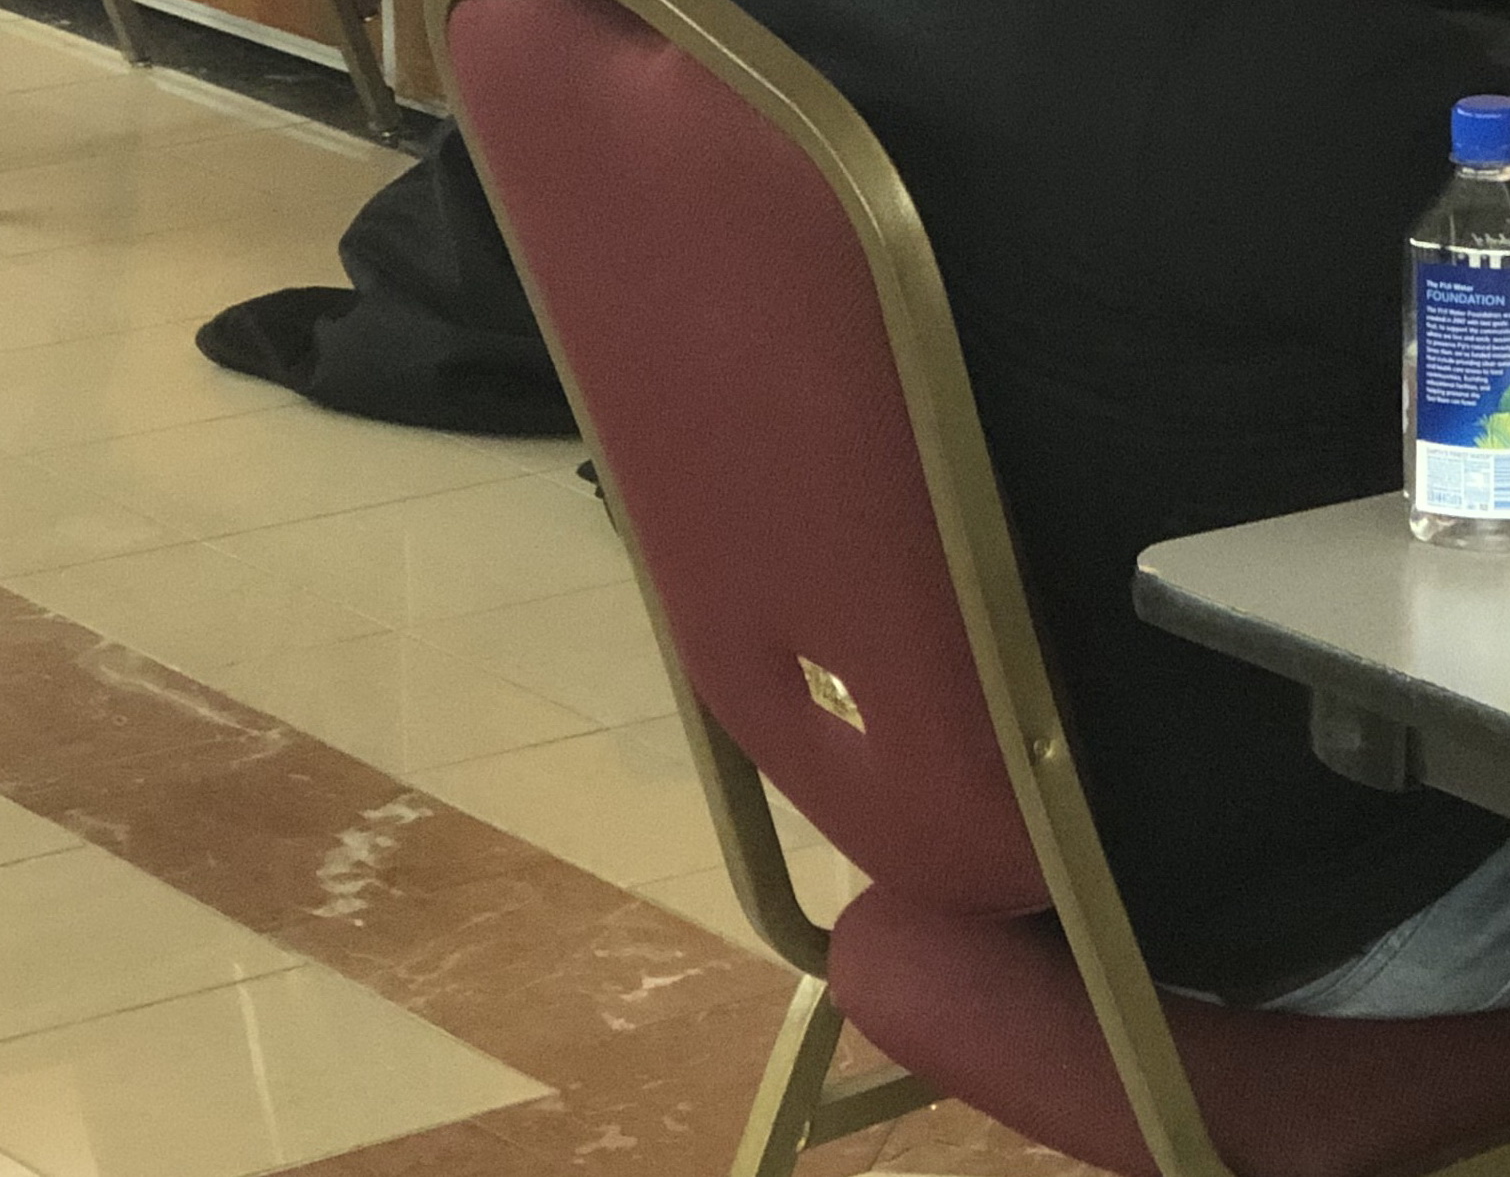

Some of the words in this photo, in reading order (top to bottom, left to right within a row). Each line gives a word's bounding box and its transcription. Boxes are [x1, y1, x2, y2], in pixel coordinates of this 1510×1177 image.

[1426, 279, 1438, 289] The
[1453, 283, 1474, 292] Water
[1426, 289, 1506, 307] FOUNDATION
